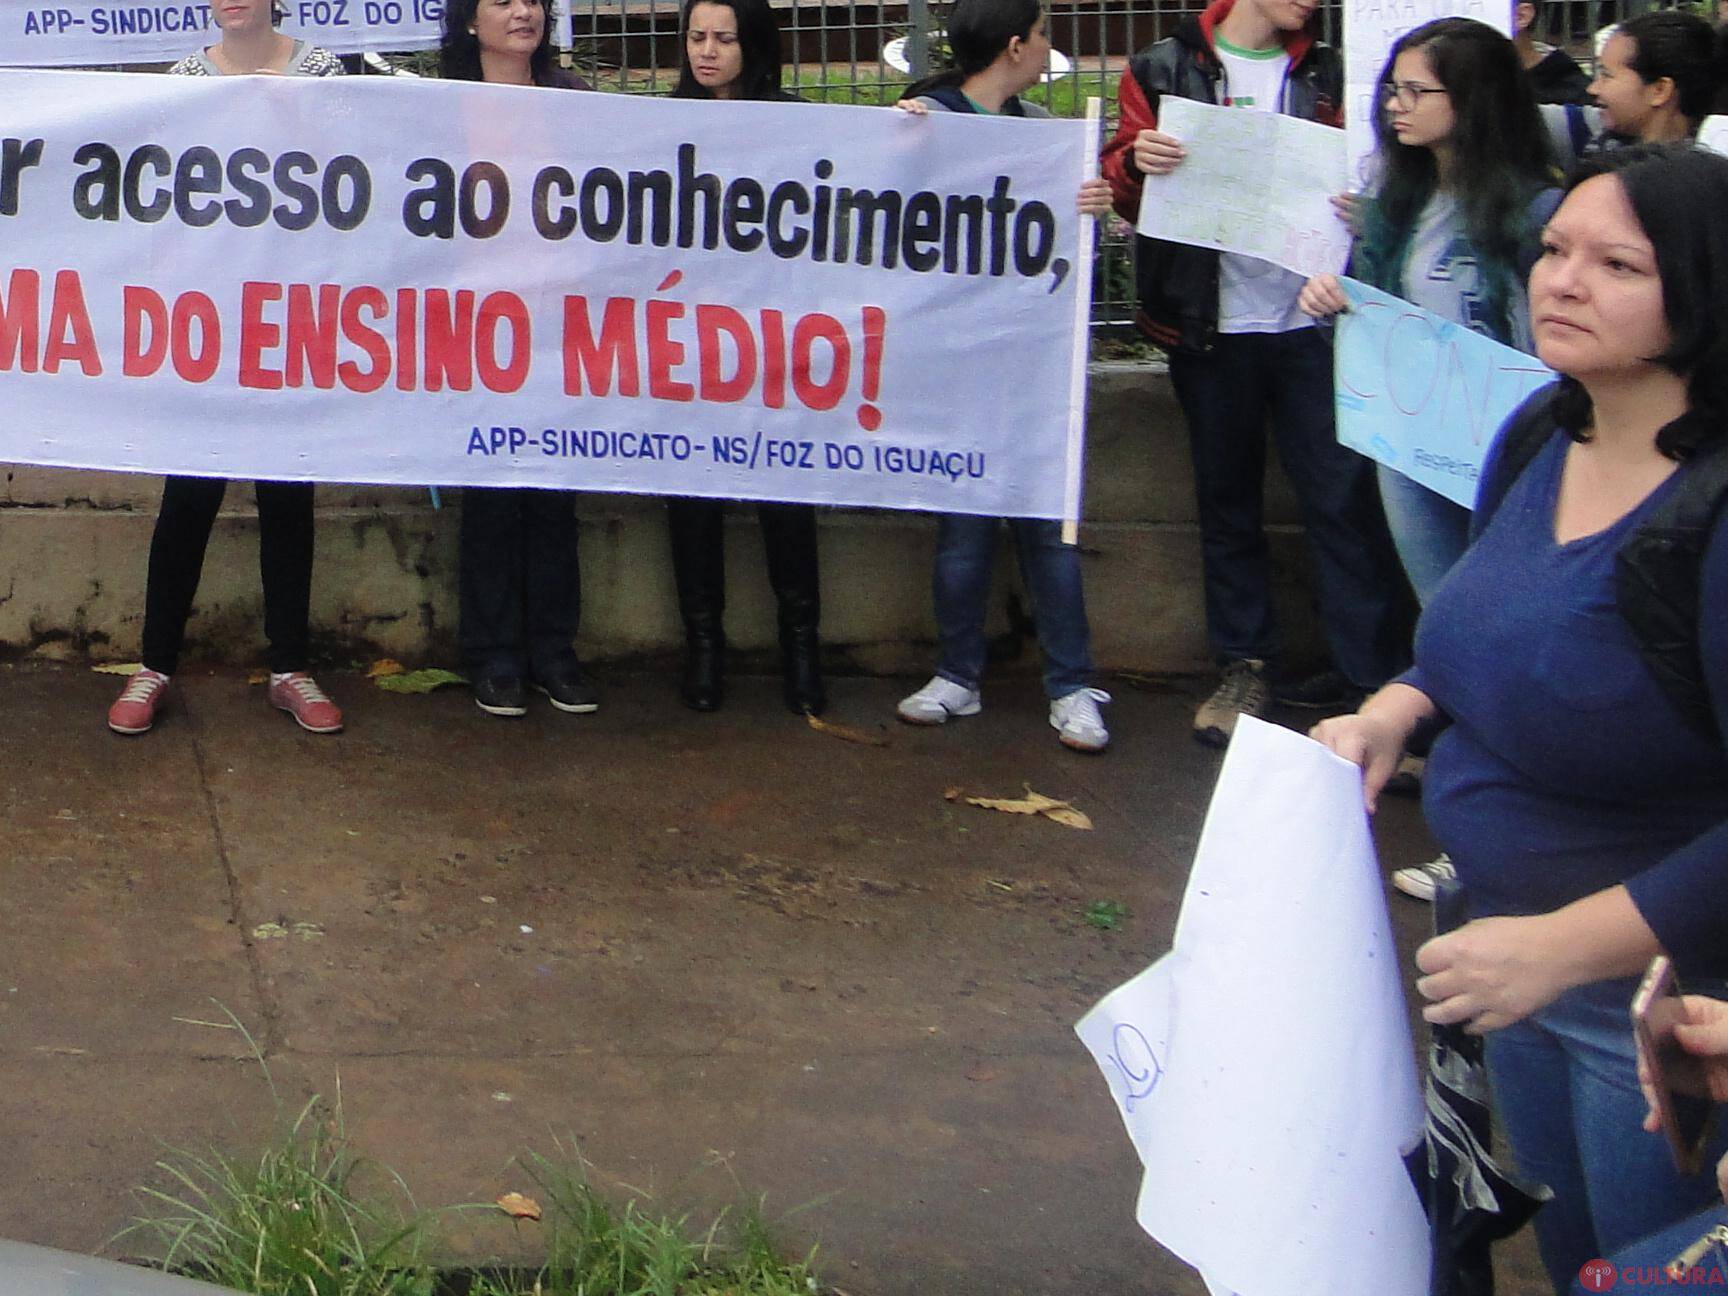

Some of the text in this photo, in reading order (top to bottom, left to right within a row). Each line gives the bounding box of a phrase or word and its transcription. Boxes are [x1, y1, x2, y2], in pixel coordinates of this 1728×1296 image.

[364, 0, 402, 27] DO
[72, 141, 372, 232] acesso
[402, 157, 511, 241] ao
[531, 142, 1070, 294] conhecimento,
[122, 285, 221, 384] DO
[238, 280, 532, 394] ENSINO
[562, 269, 887, 432] MÉDIO!
[1340, 301, 1554, 446] CONT
[826, 442, 864, 471] DO
[875, 446, 986, 483] IGUAÇU
